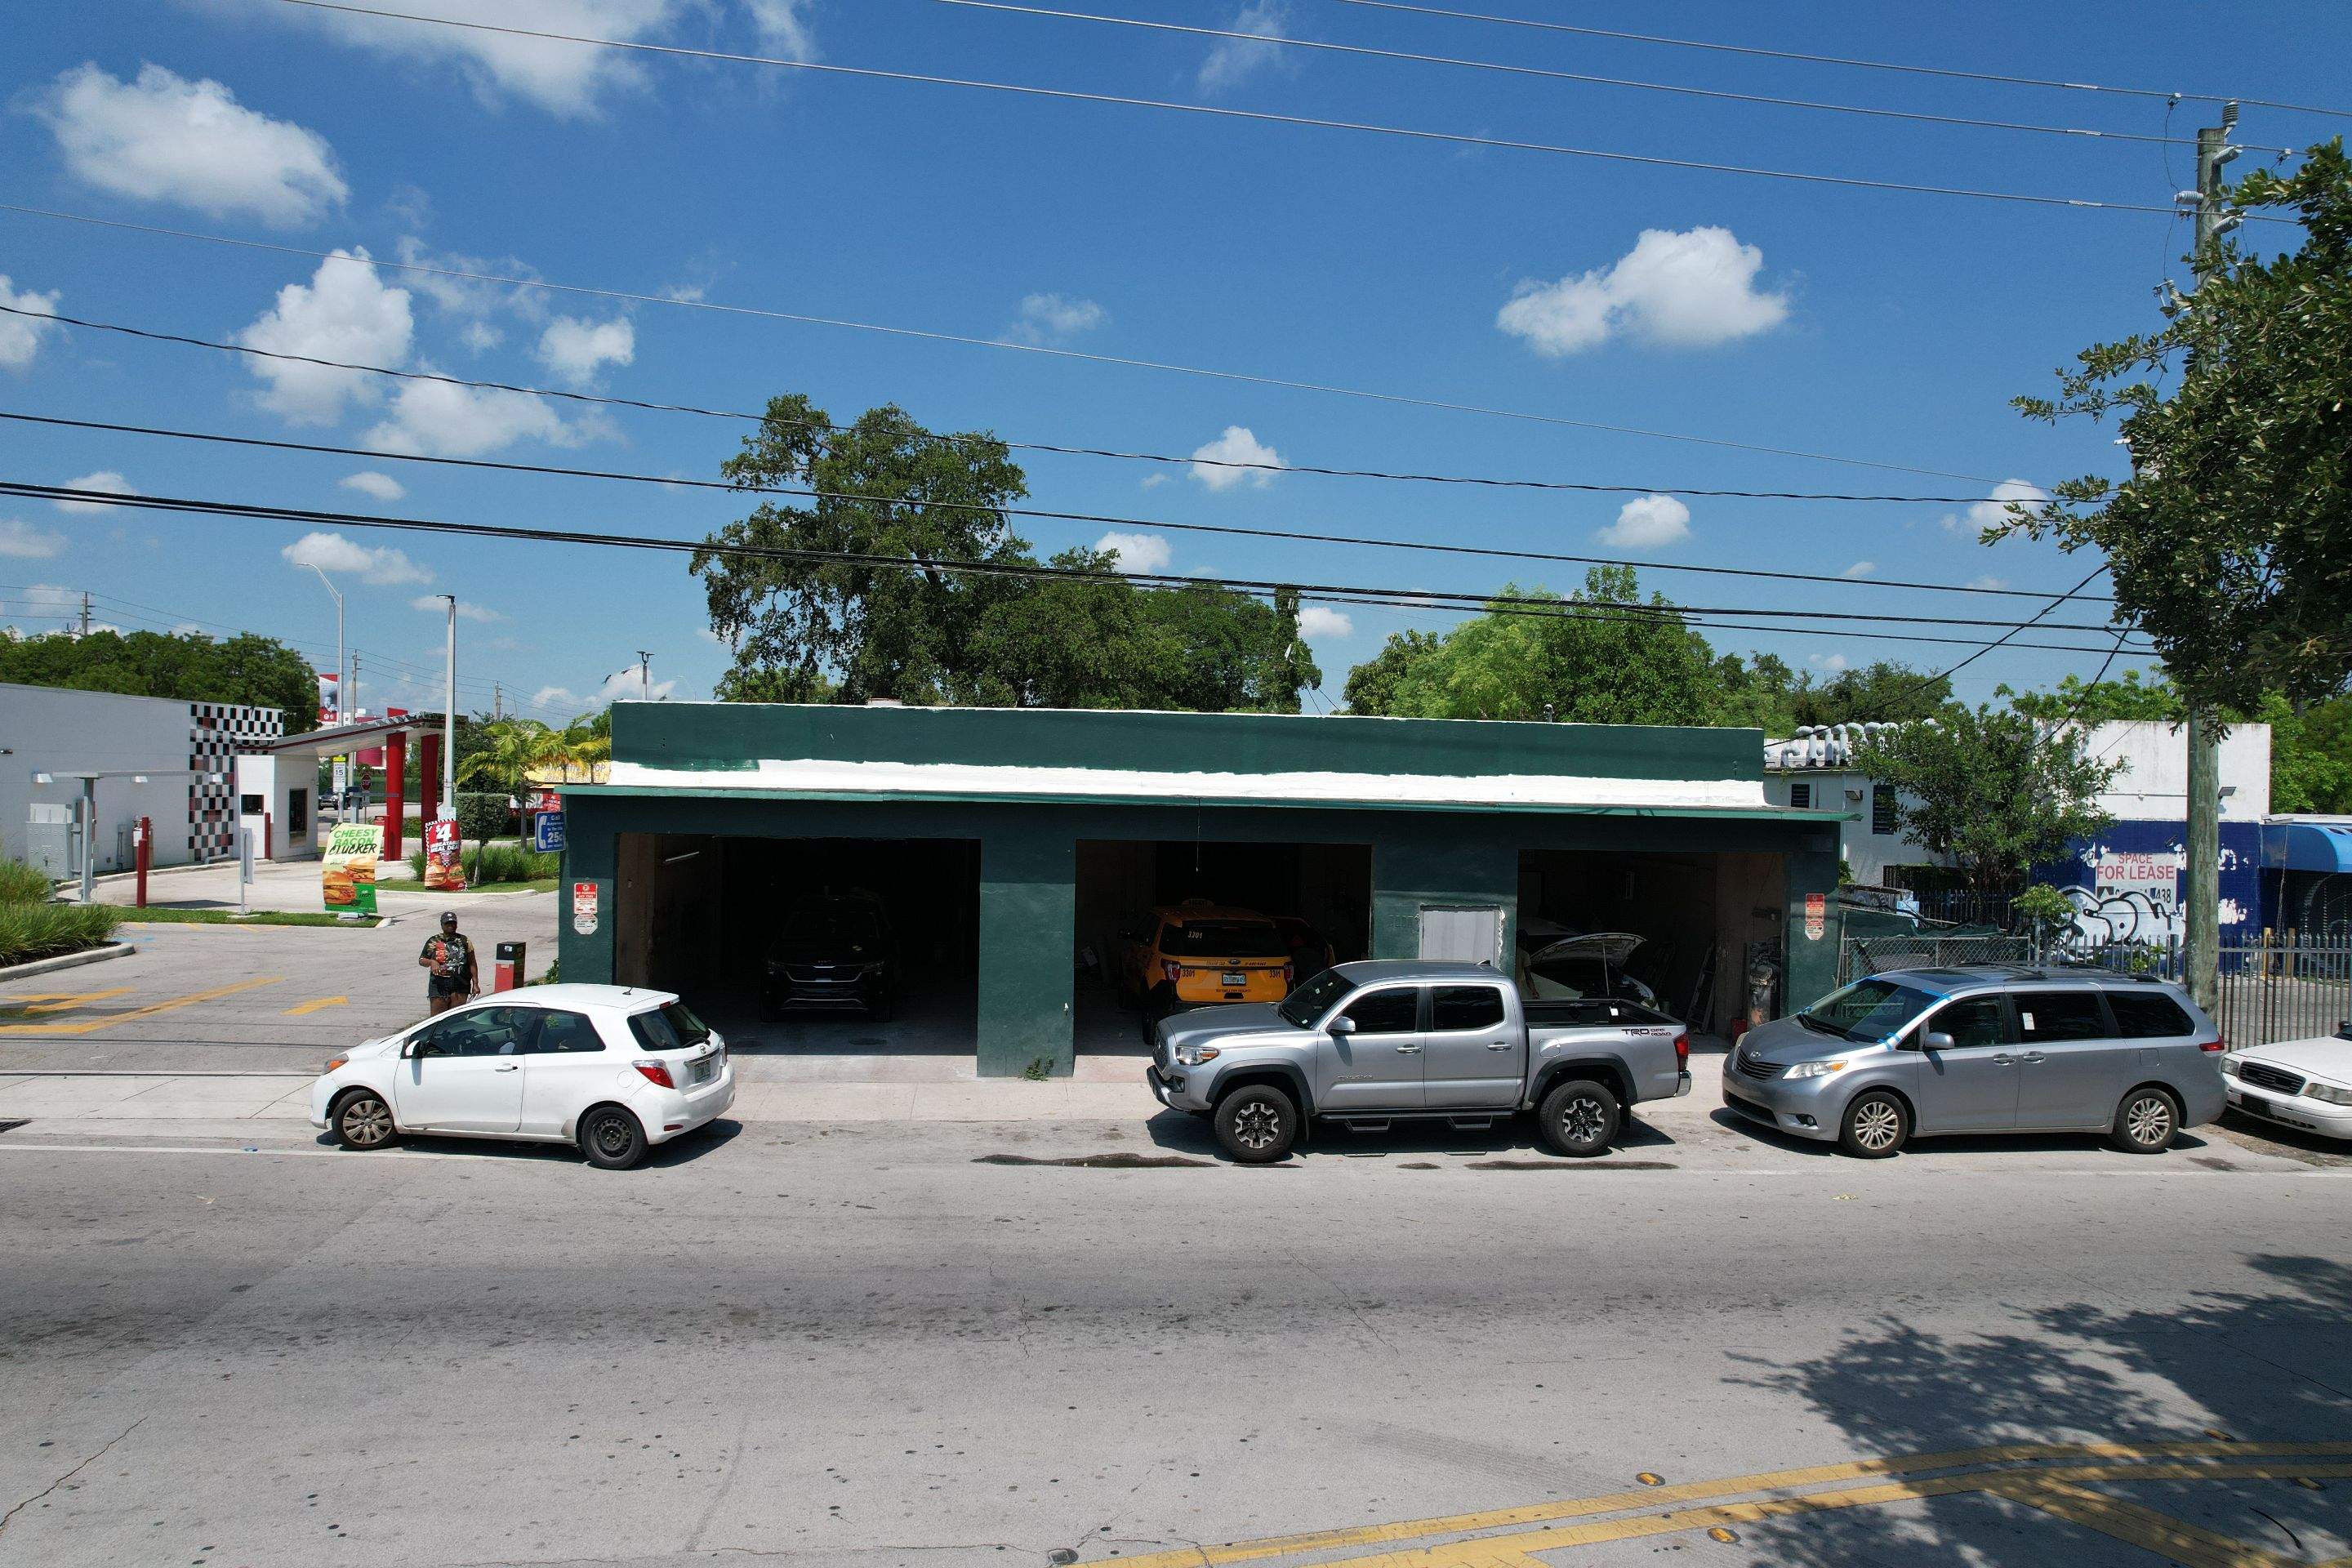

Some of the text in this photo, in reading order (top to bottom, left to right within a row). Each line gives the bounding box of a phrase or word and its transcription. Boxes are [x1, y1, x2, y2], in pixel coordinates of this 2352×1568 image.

[334, 828, 379, 839] CHEESY
[435, 823, 452, 841] $4
[335, 836, 375, 847] BACON
[328, 843, 377, 855] CLUCKER
[2118, 853, 2153, 864] SPACE
[2096, 866, 2175, 880] FOR LEASE
[1182, 969, 1196, 978] 3301
[1621, 1028, 1650, 1036] TRD
